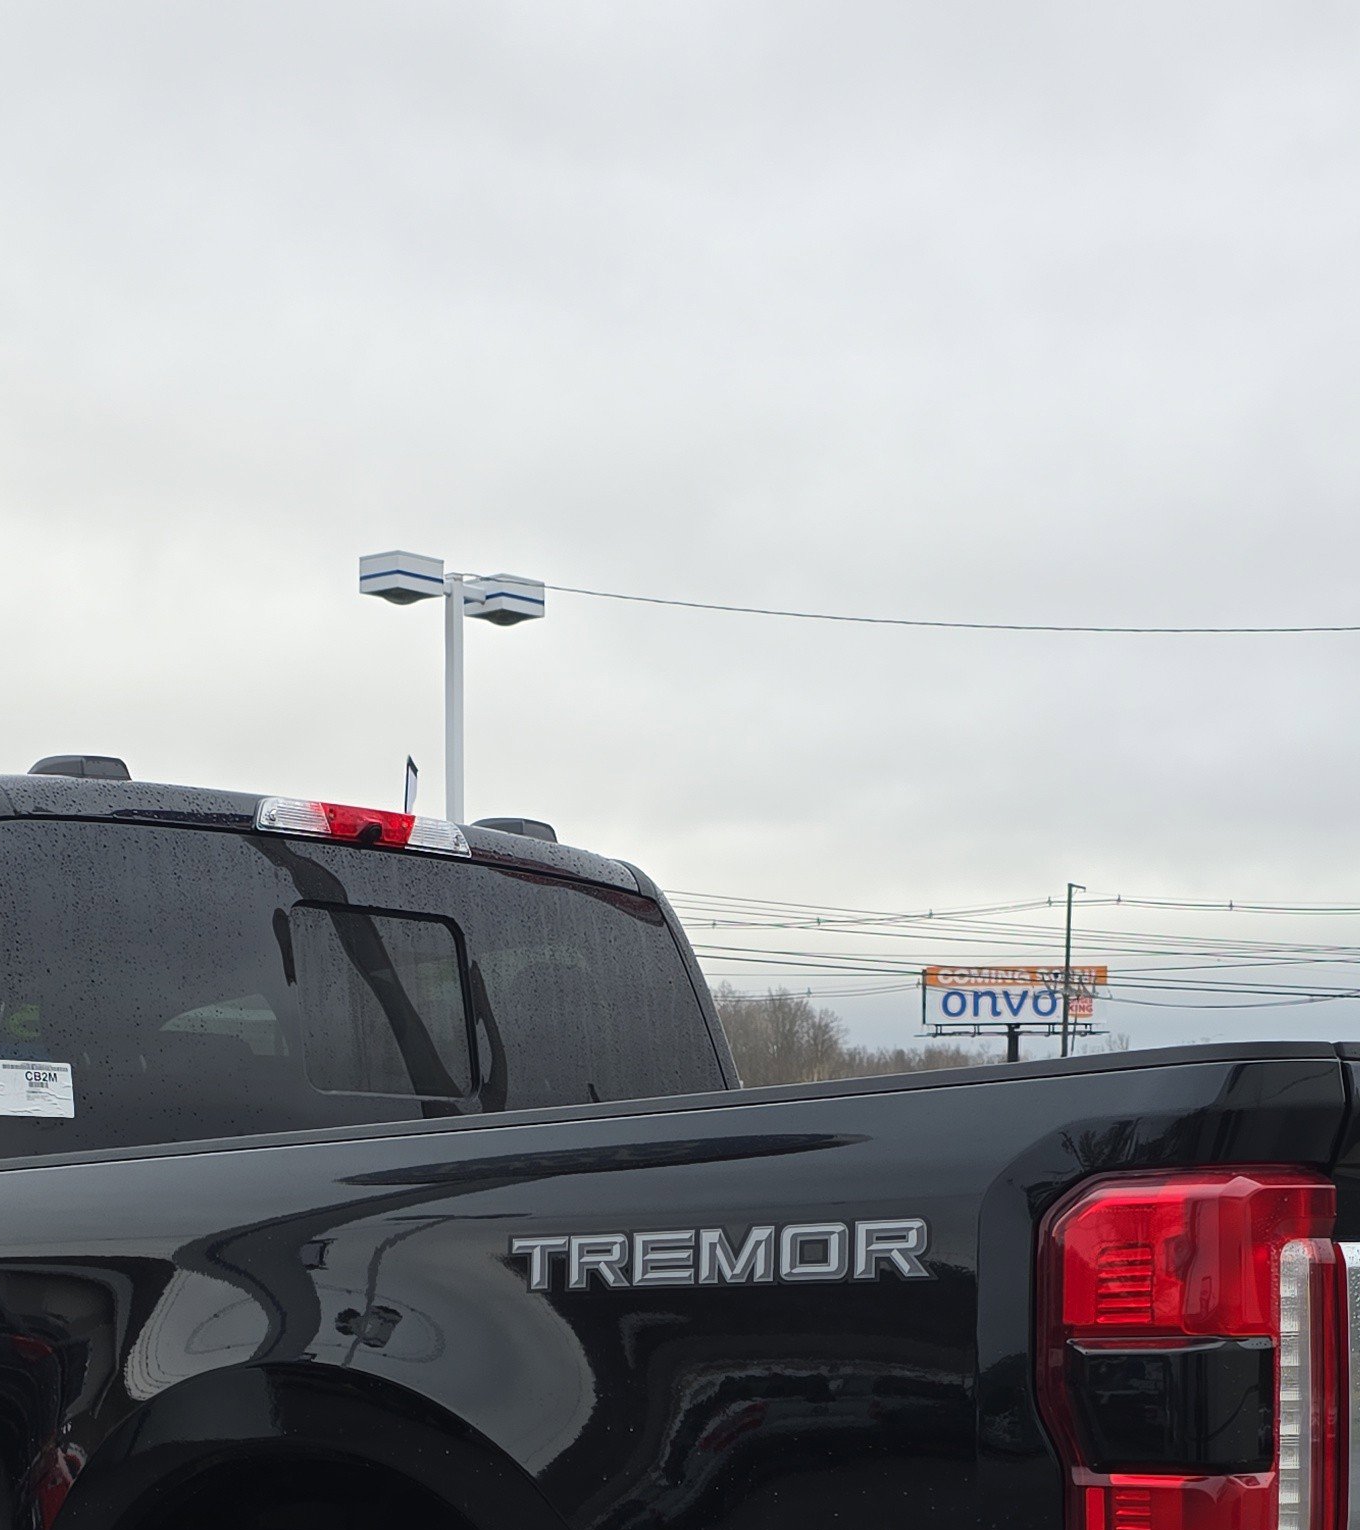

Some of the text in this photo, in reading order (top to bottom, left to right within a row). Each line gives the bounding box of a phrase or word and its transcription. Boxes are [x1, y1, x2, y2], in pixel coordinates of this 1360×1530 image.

[937, 968, 1031, 984] COMING
[942, 990, 1057, 1017] onvo
[25, 1071, 58, 1082] CB2M
[511, 1217, 933, 1291] TREMOR
